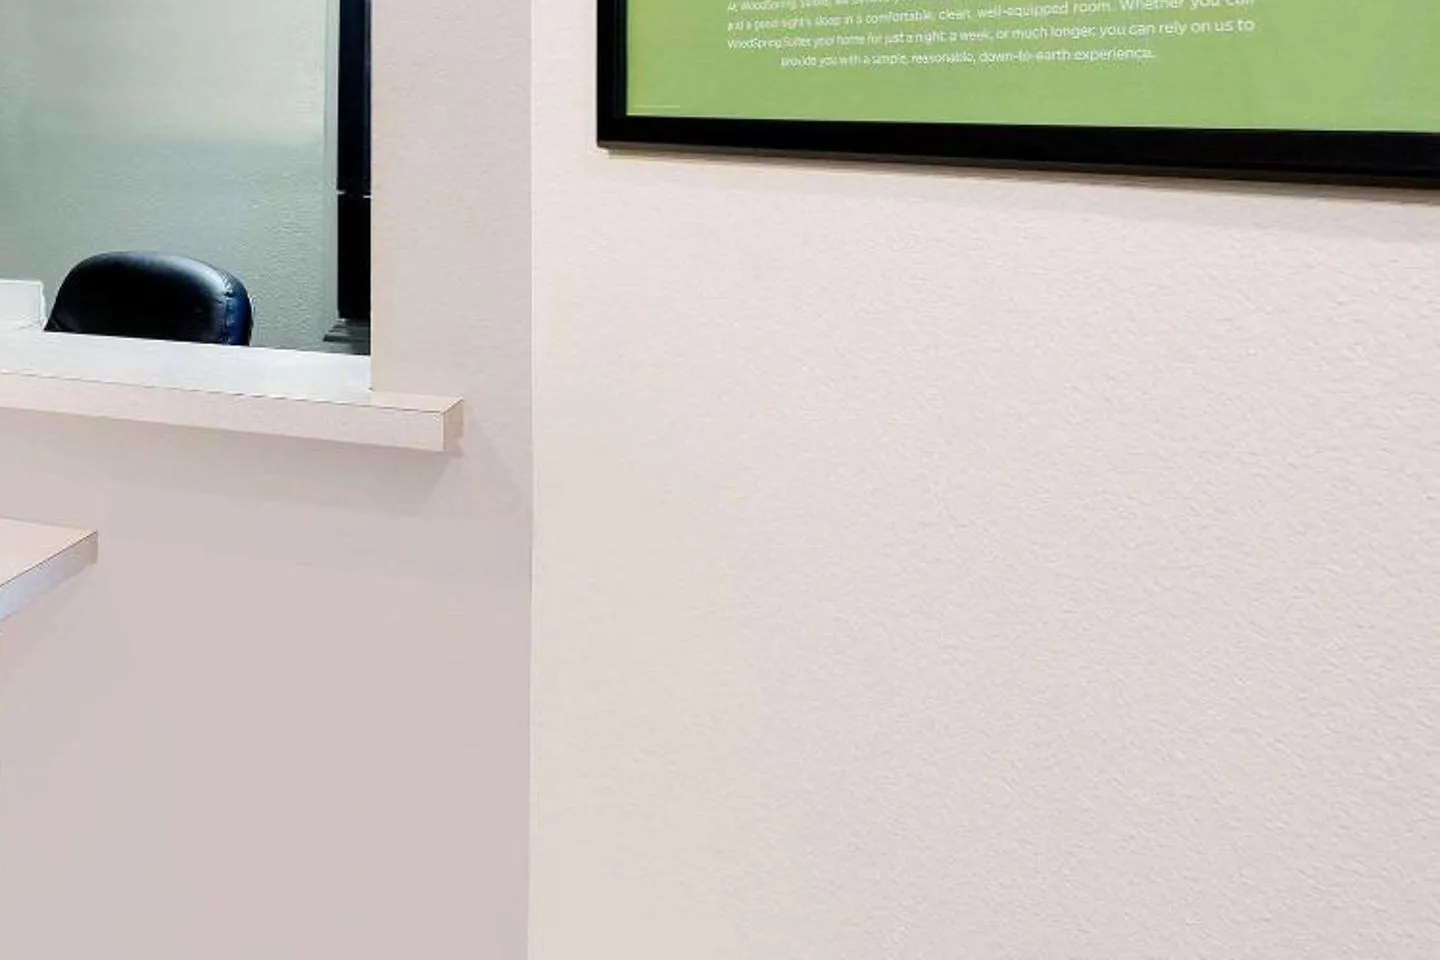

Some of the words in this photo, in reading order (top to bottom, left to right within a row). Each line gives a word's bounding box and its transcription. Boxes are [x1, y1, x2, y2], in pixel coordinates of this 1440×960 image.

[995, 29, 1008, 40] or
[1008, 27, 1047, 41] much
[1099, 24, 1126, 39] you
[1128, 23, 1157, 36] can
[1159, 20, 1188, 36] rely
[1190, 20, 1211, 33] on
[1214, 19, 1236, 32] us
[1237, 18, 1256, 32] to
